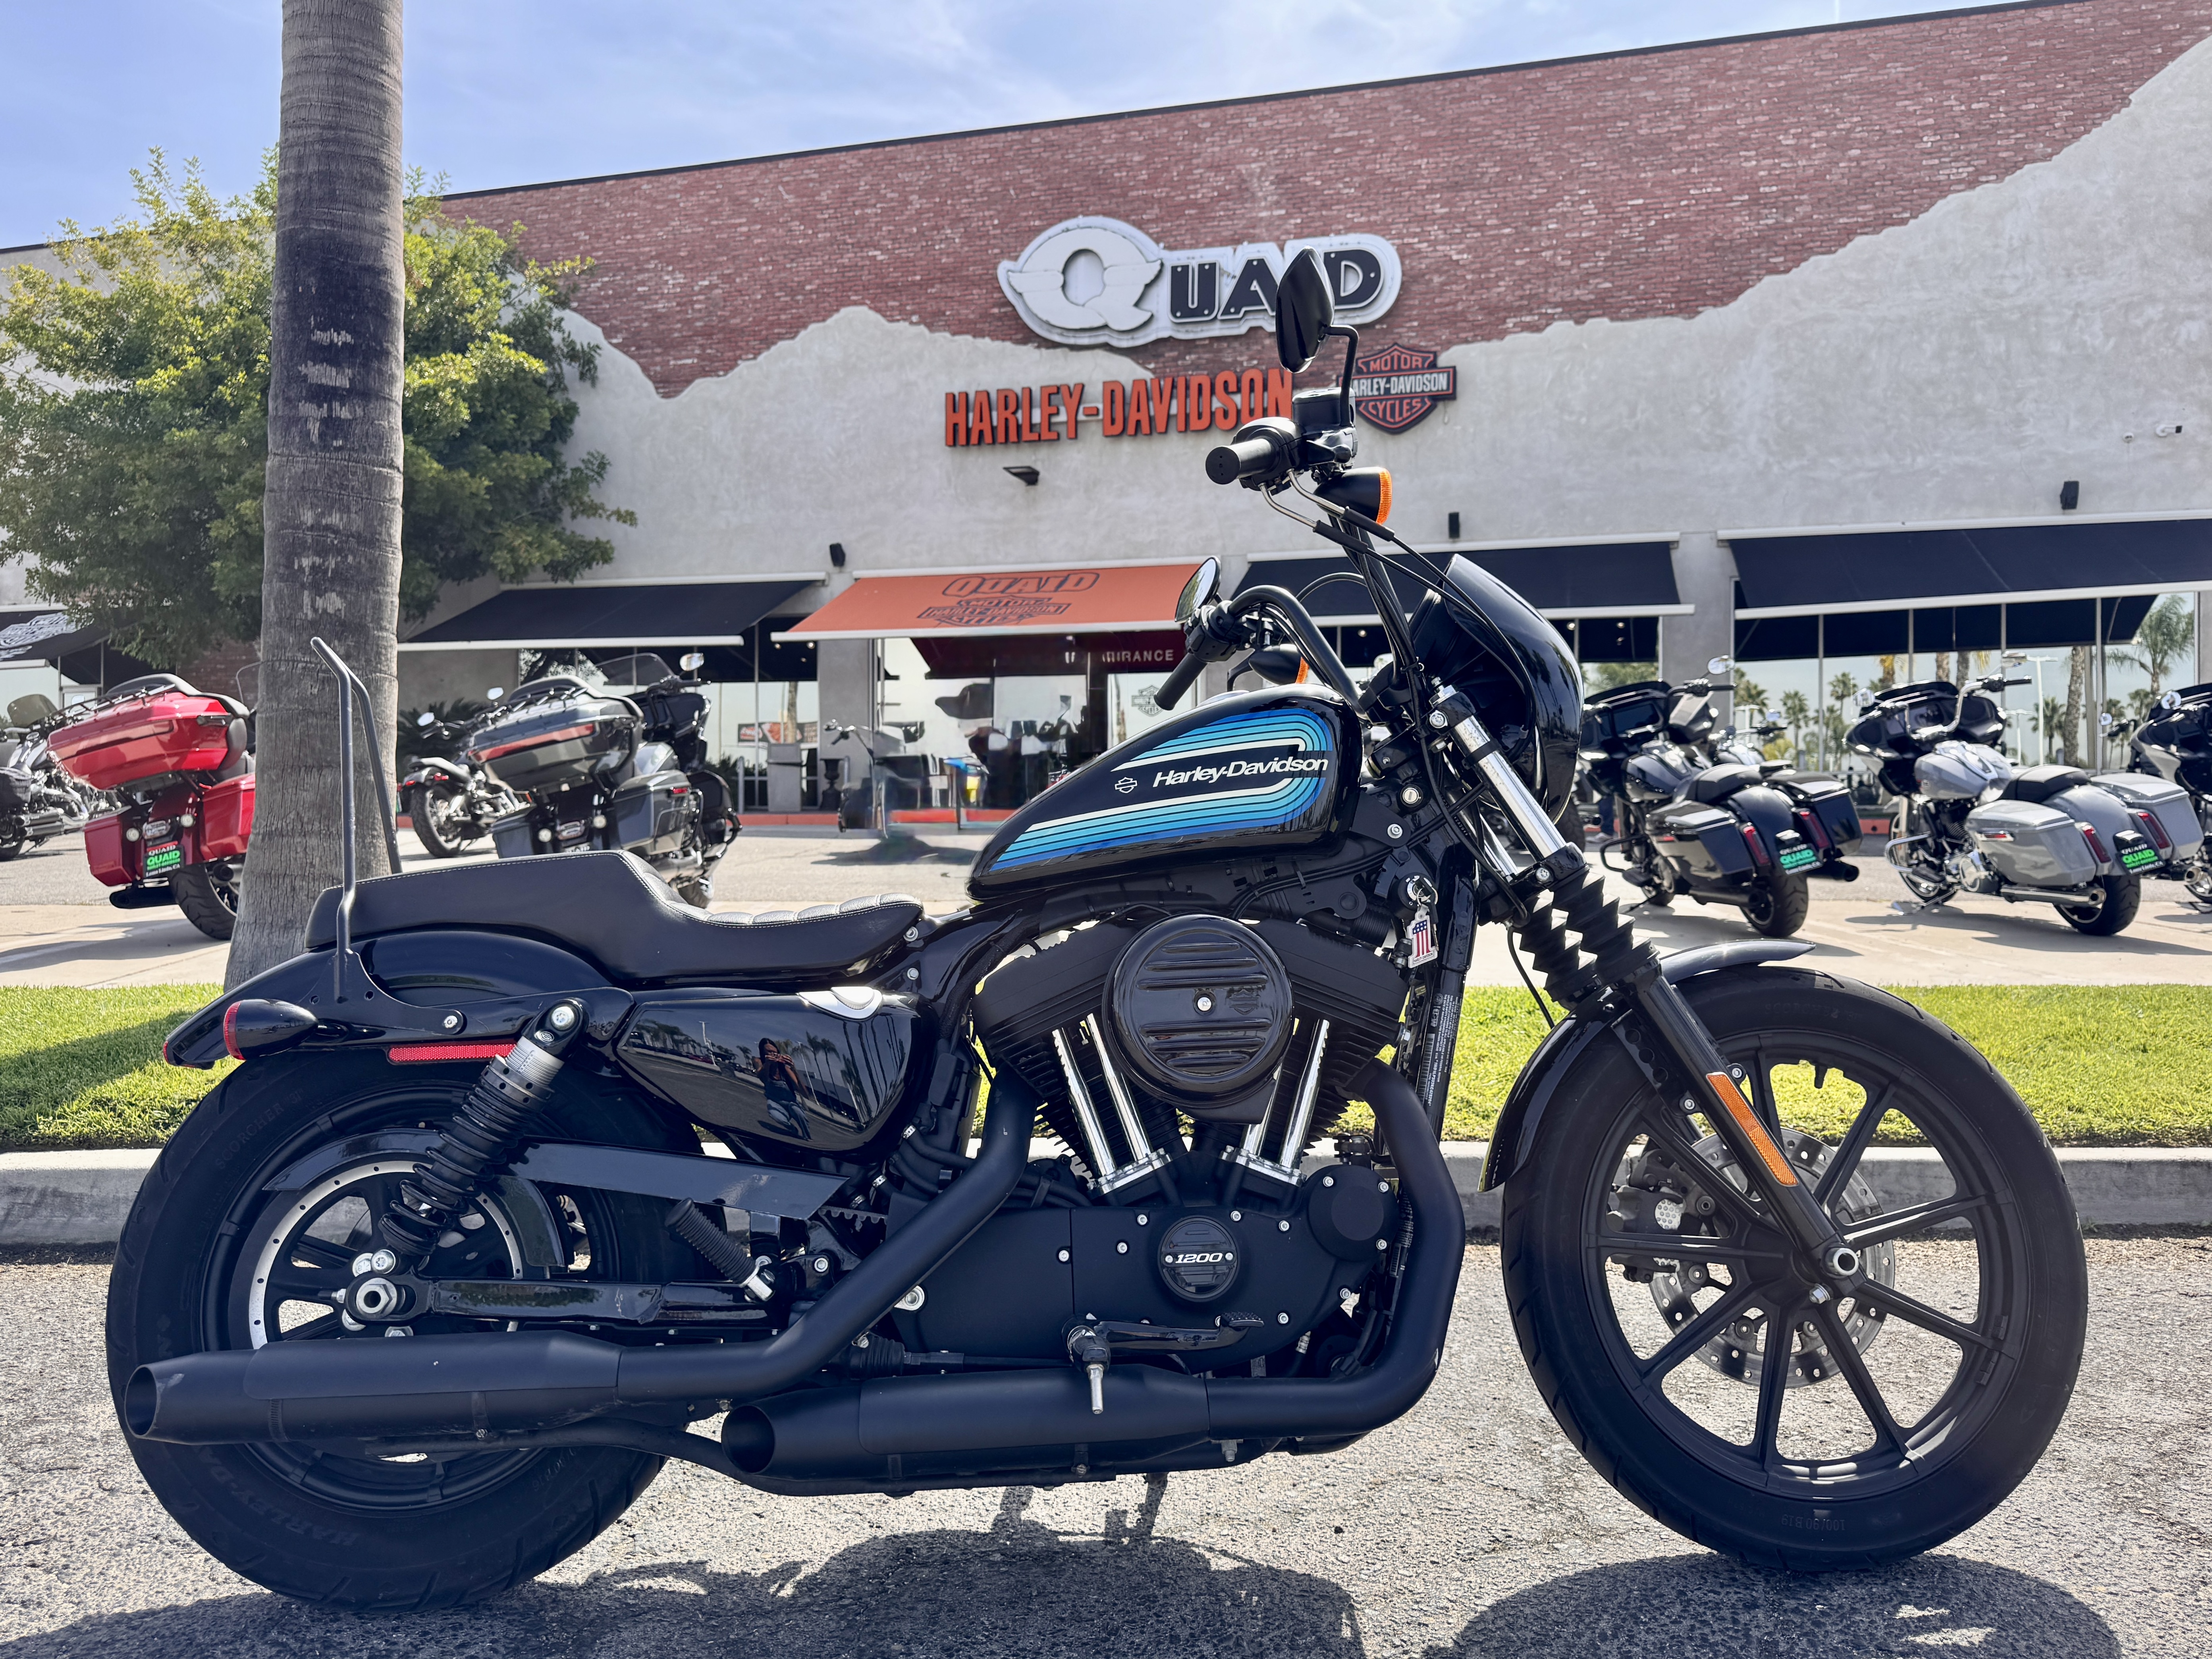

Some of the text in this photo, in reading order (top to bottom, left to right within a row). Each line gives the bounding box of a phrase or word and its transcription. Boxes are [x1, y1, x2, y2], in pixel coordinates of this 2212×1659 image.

[1007, 228, 1385, 331] QUAD
[1370, 352, 1423, 372] MOTOR
[1352, 372, 1448, 397] ARLEY-DAVIDSON
[945, 369, 1293, 446] HARLEY-DAVIDSON
[1369, 398, 1421, 423] CYCLES
[942, 572, 1100, 598] QUAID
[932, 605, 1059, 616] HARLEY-DAVIDSON
[1153, 756, 1329, 788] Harley-Davidson
[147, 850, 180, 866] QUAID
[148, 845, 176, 856] QUAID
[1780, 849, 1813, 864] QUAID
[2121, 849, 2155, 864] QUAID
[1175, 1252, 1223, 1264] 1200
[1805, 1518, 1846, 1531] 100/90
